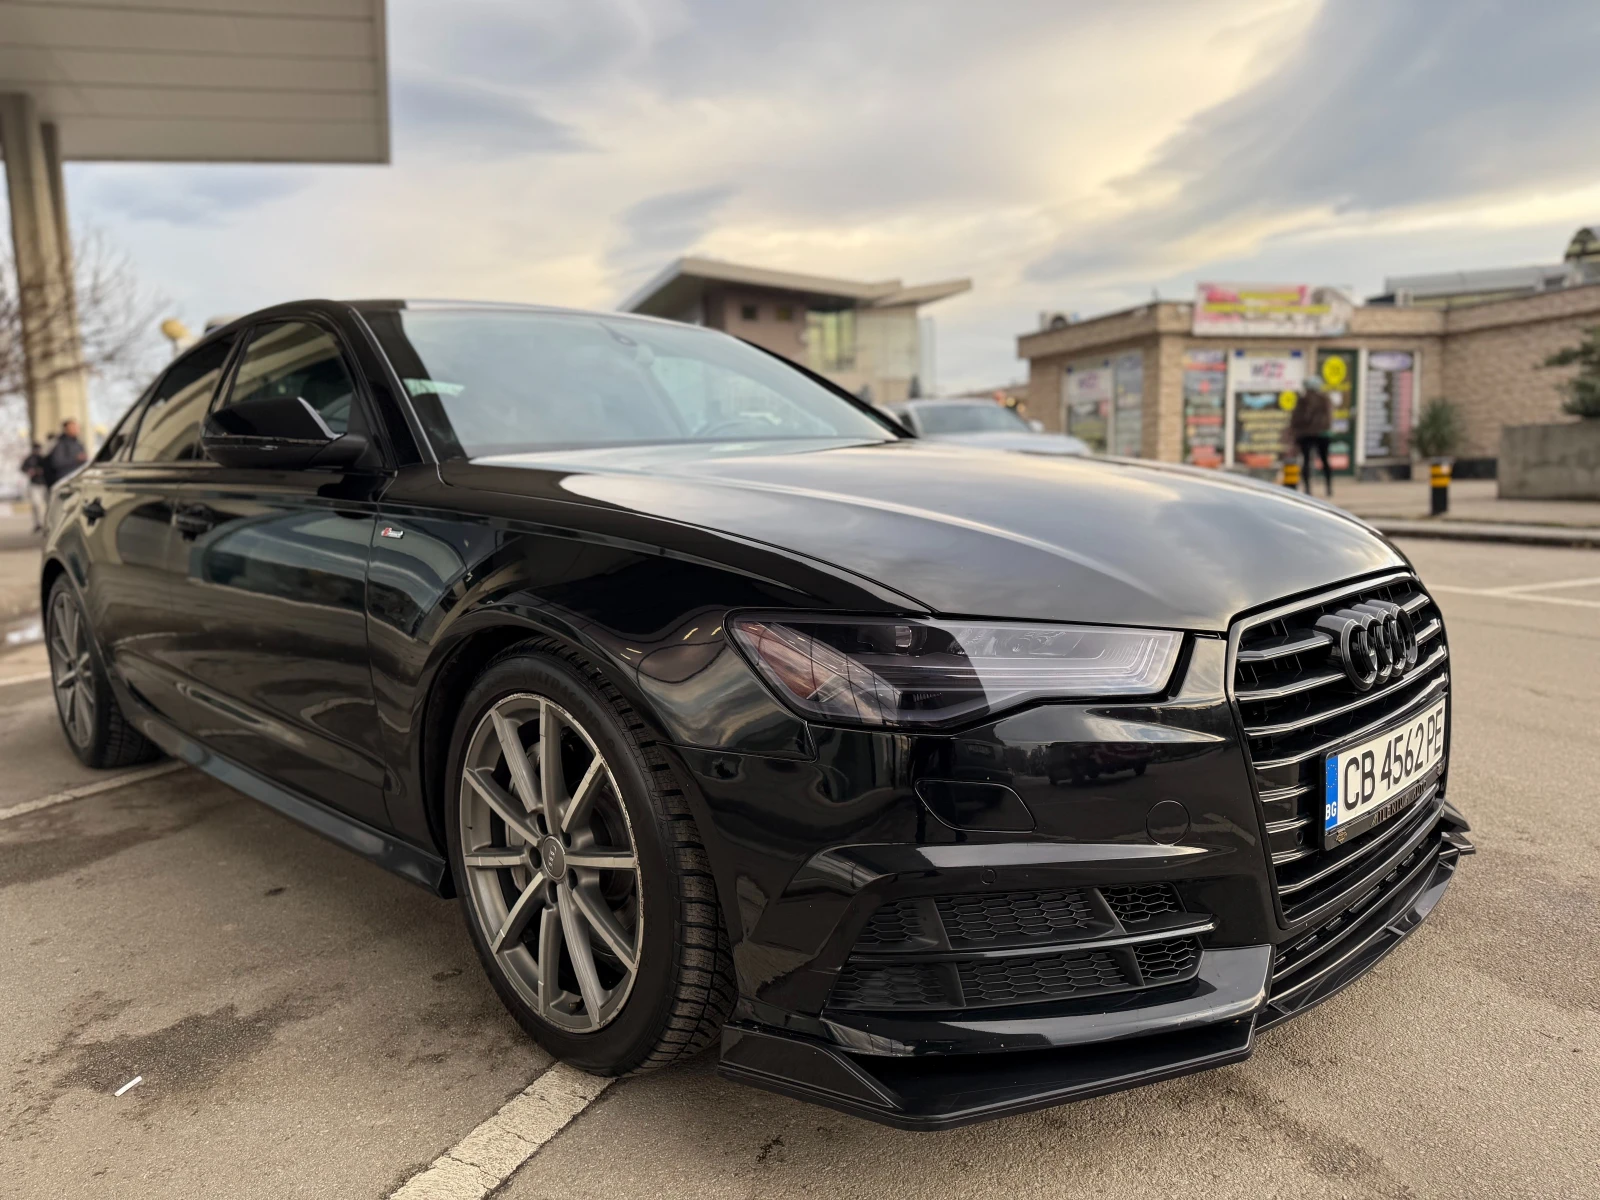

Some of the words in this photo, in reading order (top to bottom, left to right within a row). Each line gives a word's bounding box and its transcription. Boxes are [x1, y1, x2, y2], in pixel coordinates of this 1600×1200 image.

[1344, 750, 1375, 811] CB
[1380, 722, 1424, 791] 4562
[1427, 707, 1443, 764] PE
[1326, 801, 1337, 821] BG
